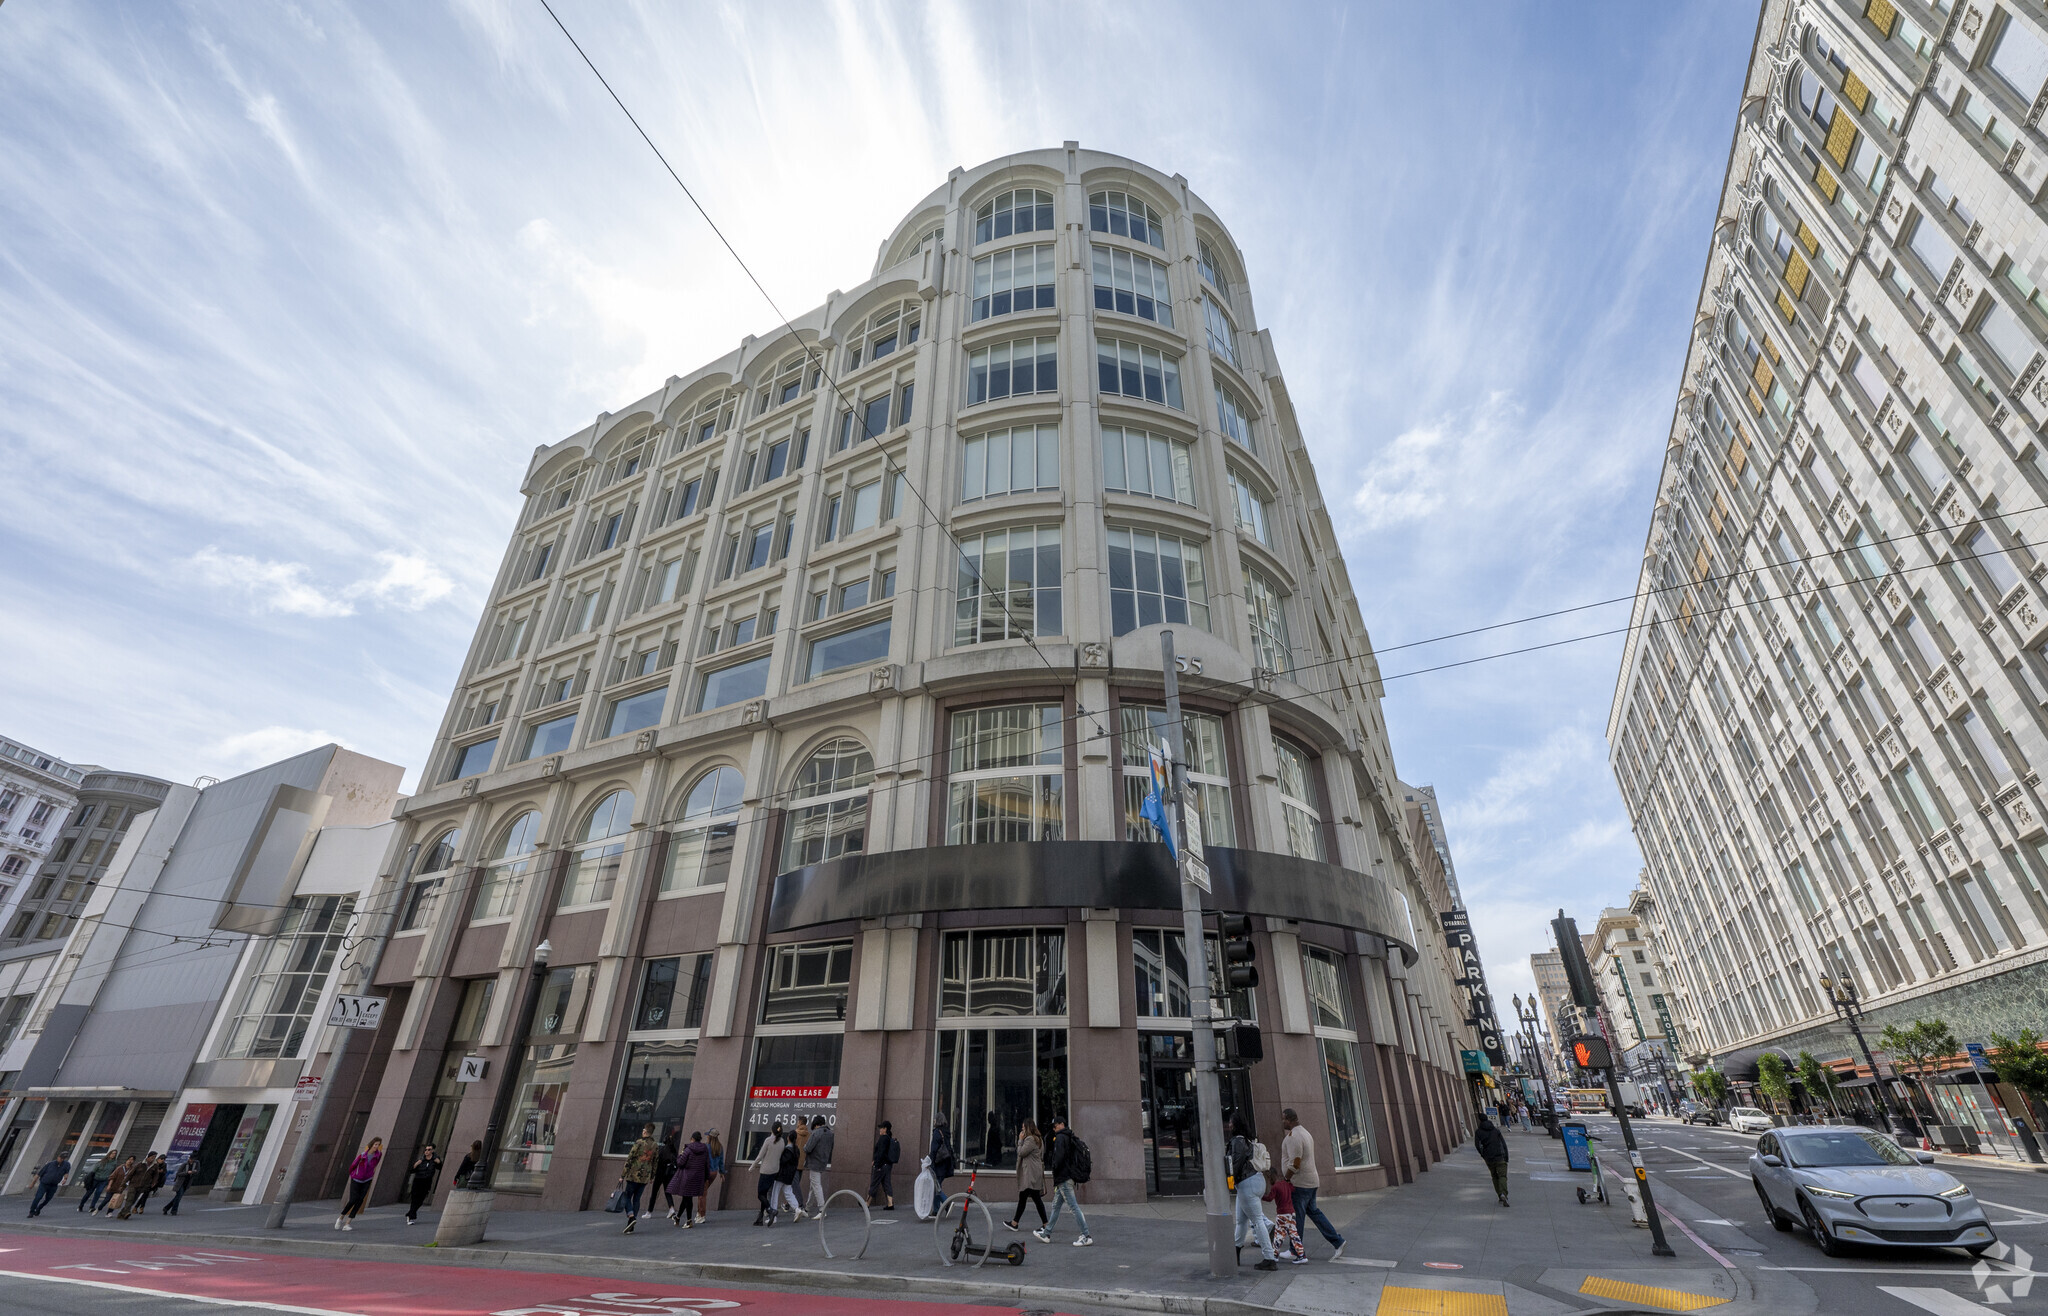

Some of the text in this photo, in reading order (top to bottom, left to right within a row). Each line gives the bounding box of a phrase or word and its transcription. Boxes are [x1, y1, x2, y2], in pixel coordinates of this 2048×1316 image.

[1175, 655, 1203, 675] 55
[1459, 934, 1497, 1049] PARKING
[1662, 1015, 1677, 1050] HOTEL
[754, 1089, 779, 1097] RETAIL
[781, 1089, 797, 1097] FOR
[799, 1089, 823, 1097] LEASE
[184, 1114, 200, 1123] RETAIL
[749, 1113, 769, 1125] 415
[178, 1127, 206, 1137] FOR LEASE
[48, 1252, 264, 1274] TAXI
